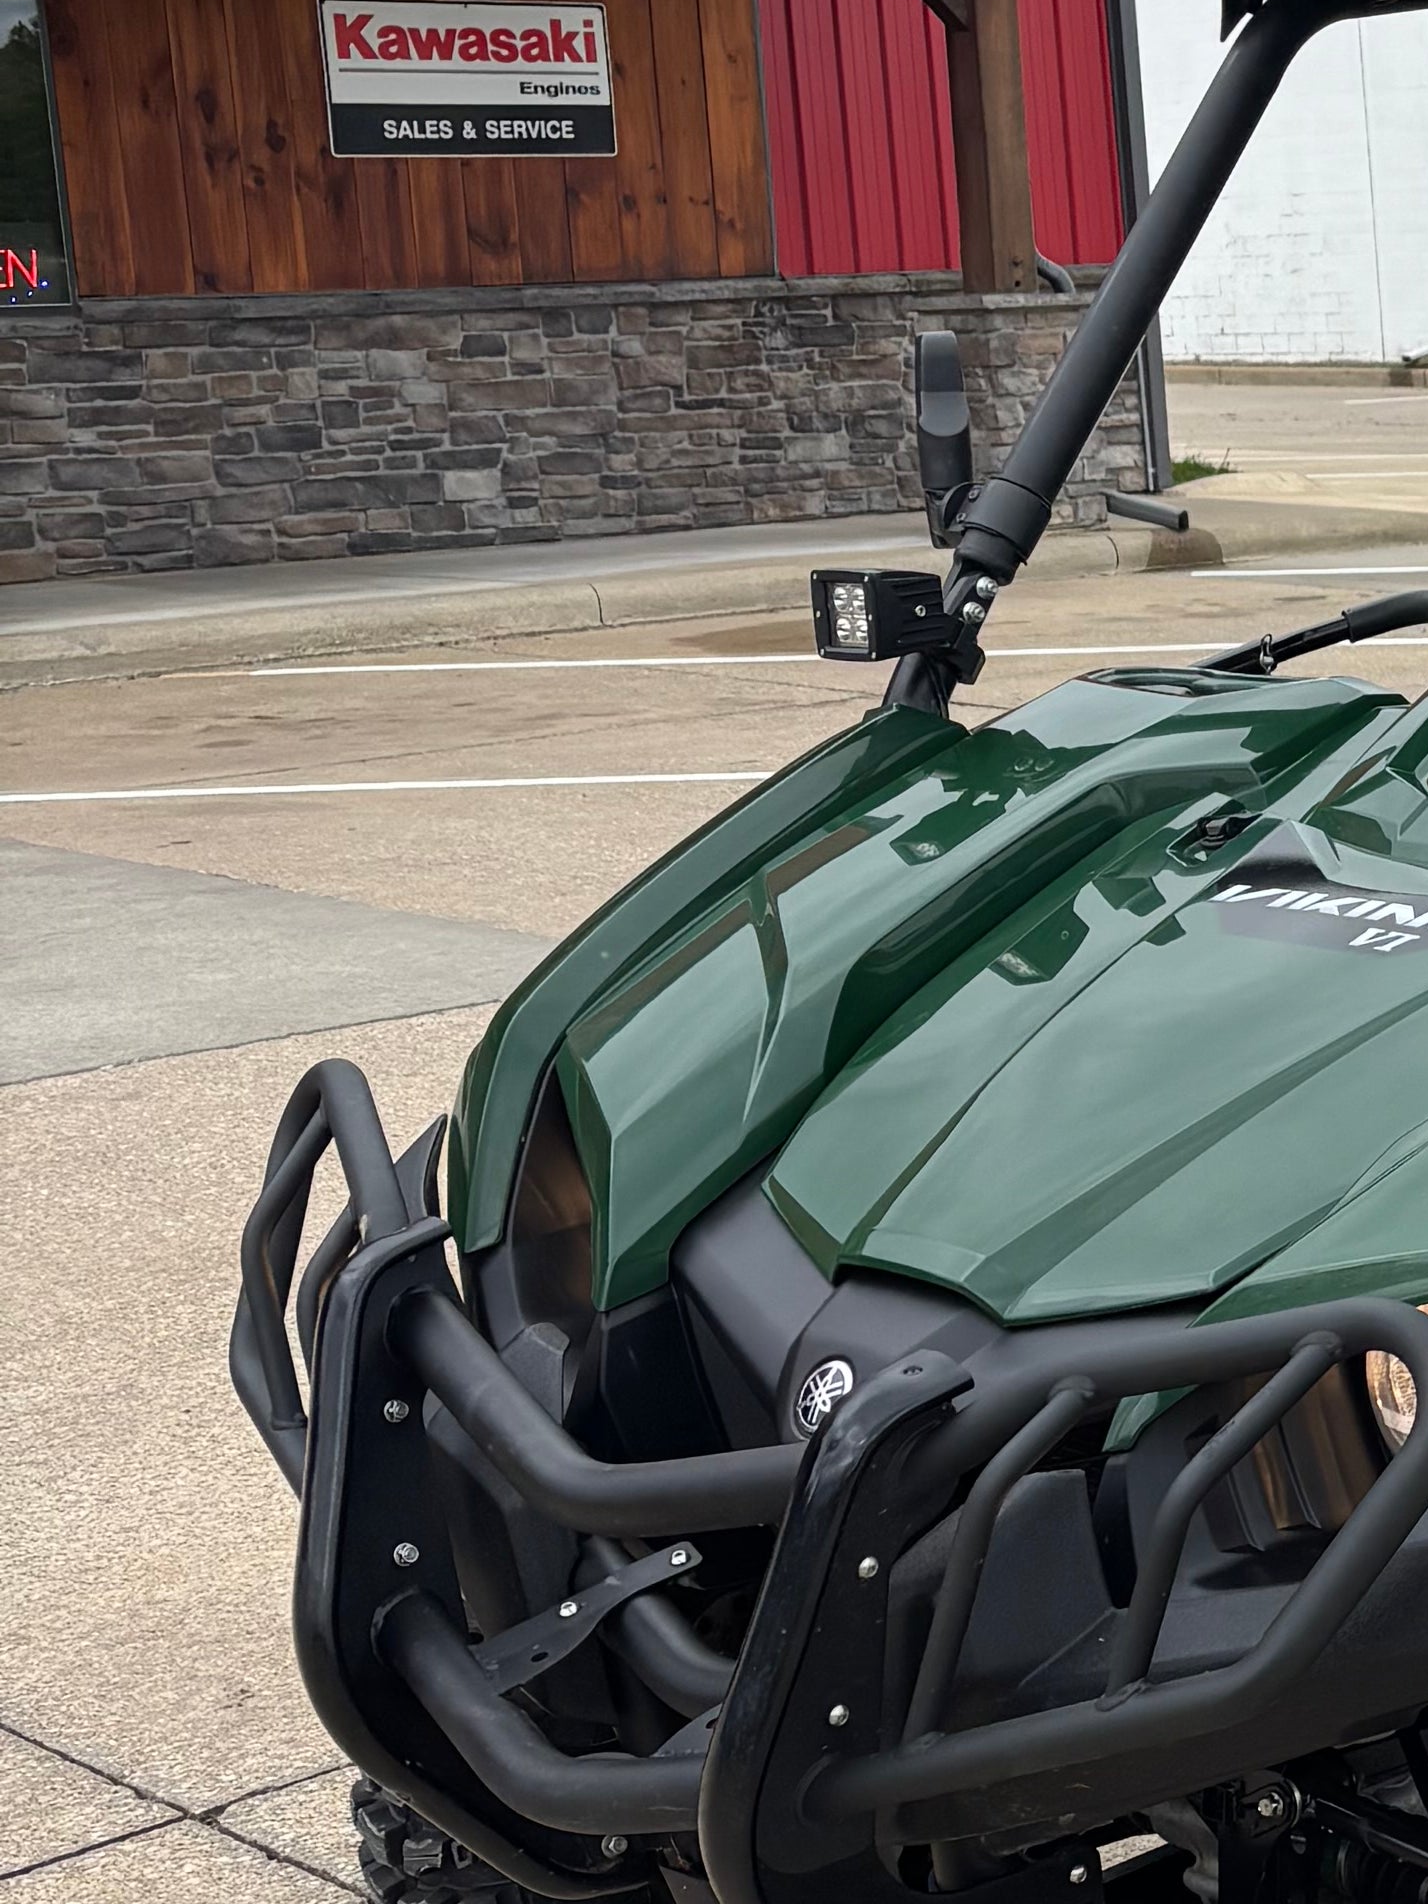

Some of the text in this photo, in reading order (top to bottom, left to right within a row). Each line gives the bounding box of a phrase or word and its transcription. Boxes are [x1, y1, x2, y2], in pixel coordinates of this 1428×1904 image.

[332, 13, 598, 64] Kawasaki
[519, 81, 601, 98] Engines
[383, 119, 575, 140] SALES & SERVICE
[1348, 927, 1421, 952] VI
